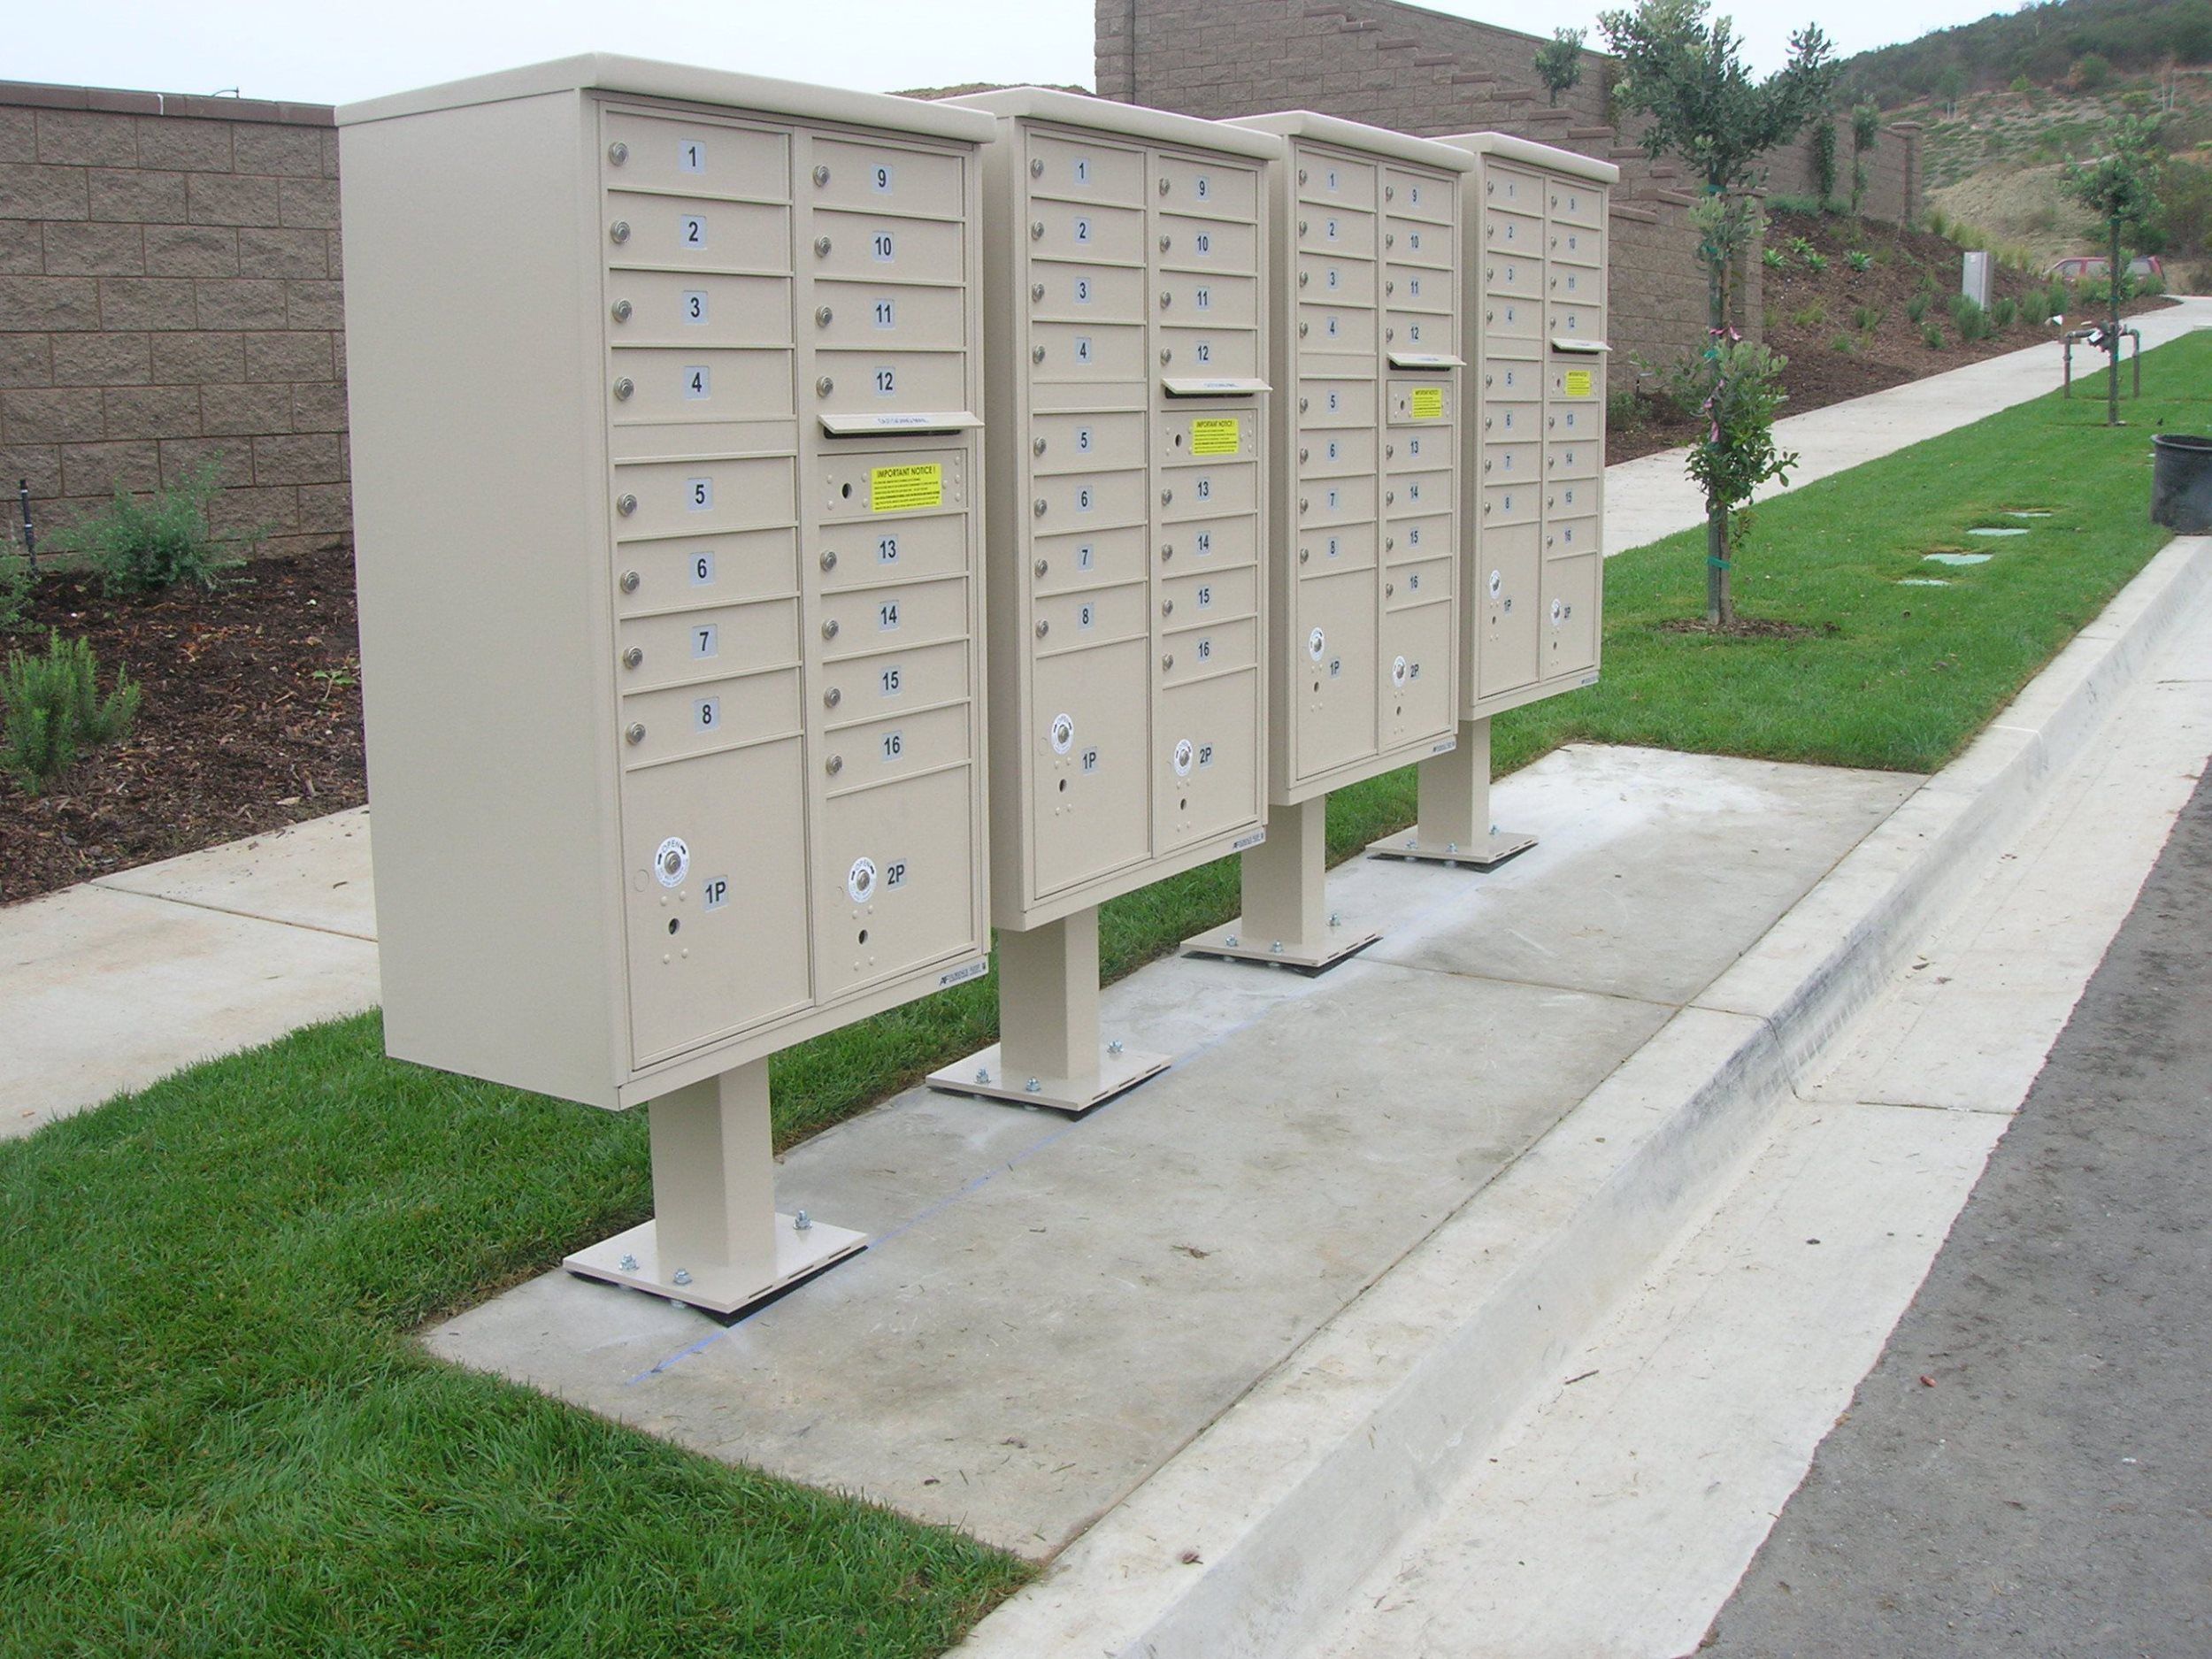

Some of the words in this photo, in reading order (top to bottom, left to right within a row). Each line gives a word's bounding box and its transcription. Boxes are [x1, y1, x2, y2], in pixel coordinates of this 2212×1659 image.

[688, 146, 695, 167] 1
[878, 169, 886, 188] 9
[1079, 162, 1084, 179] 1
[1199, 180, 1205, 196] 9
[1329, 173, 1335, 187] 1
[688, 221, 698, 242] 2
[1079, 222, 1086, 239] 2
[1329, 222, 1335, 236] 2
[875, 237, 891, 256] 10
[1197, 235, 1208, 251] 10
[1409, 234, 1420, 249] 10
[1330, 272, 1336, 286] 3
[1409, 280, 1419, 294] 11
[1079, 282, 1087, 299] 3
[1197, 291, 1208, 305] 11
[690, 297, 700, 318] 3
[876, 304, 890, 323] 11
[1329, 321, 1336, 334] 4
[1409, 326, 1420, 340] 12
[1079, 342, 1087, 358] 4
[1198, 345, 1209, 361] 12
[692, 372, 702, 392] 4
[877, 372, 893, 390] 12
[1330, 395, 1336, 408] 5
[1081, 432, 1087, 449] 5
[1409, 441, 1419, 454] 13
[1329, 443, 1336, 457] 6
[877, 467, 910, 478] IMPORTANT
[695, 484, 705, 504] 5
[1198, 481, 1209, 496] 13
[1409, 486, 1419, 498] 14
[1081, 490, 1087, 507] 6
[1329, 493, 1336, 506] 7
[1198, 534, 1209, 550] 14
[1409, 530, 1419, 543] 15
[879, 540, 896, 558] 13
[1330, 541, 1336, 554] 8
[1081, 549, 1088, 565] 7
[697, 558, 707, 579] 6
[1409, 575, 1419, 588] 16
[1199, 588, 1210, 604] 15
[881, 605, 897, 625] 14
[1082, 608, 1089, 625] 8
[699, 631, 709, 651] 7
[1199, 641, 1210, 657] 16
[1329, 661, 1340, 675] 1P
[1409, 664, 1420, 678] 2P
[883, 671, 899, 690] 15
[703, 704, 711, 725] 8
[884, 736, 900, 756] 16
[1083, 752, 1096, 769] 1P
[1200, 747, 1211, 764] 2P
[887, 864, 904, 885] 2P
[705, 881, 726, 903] 1P
